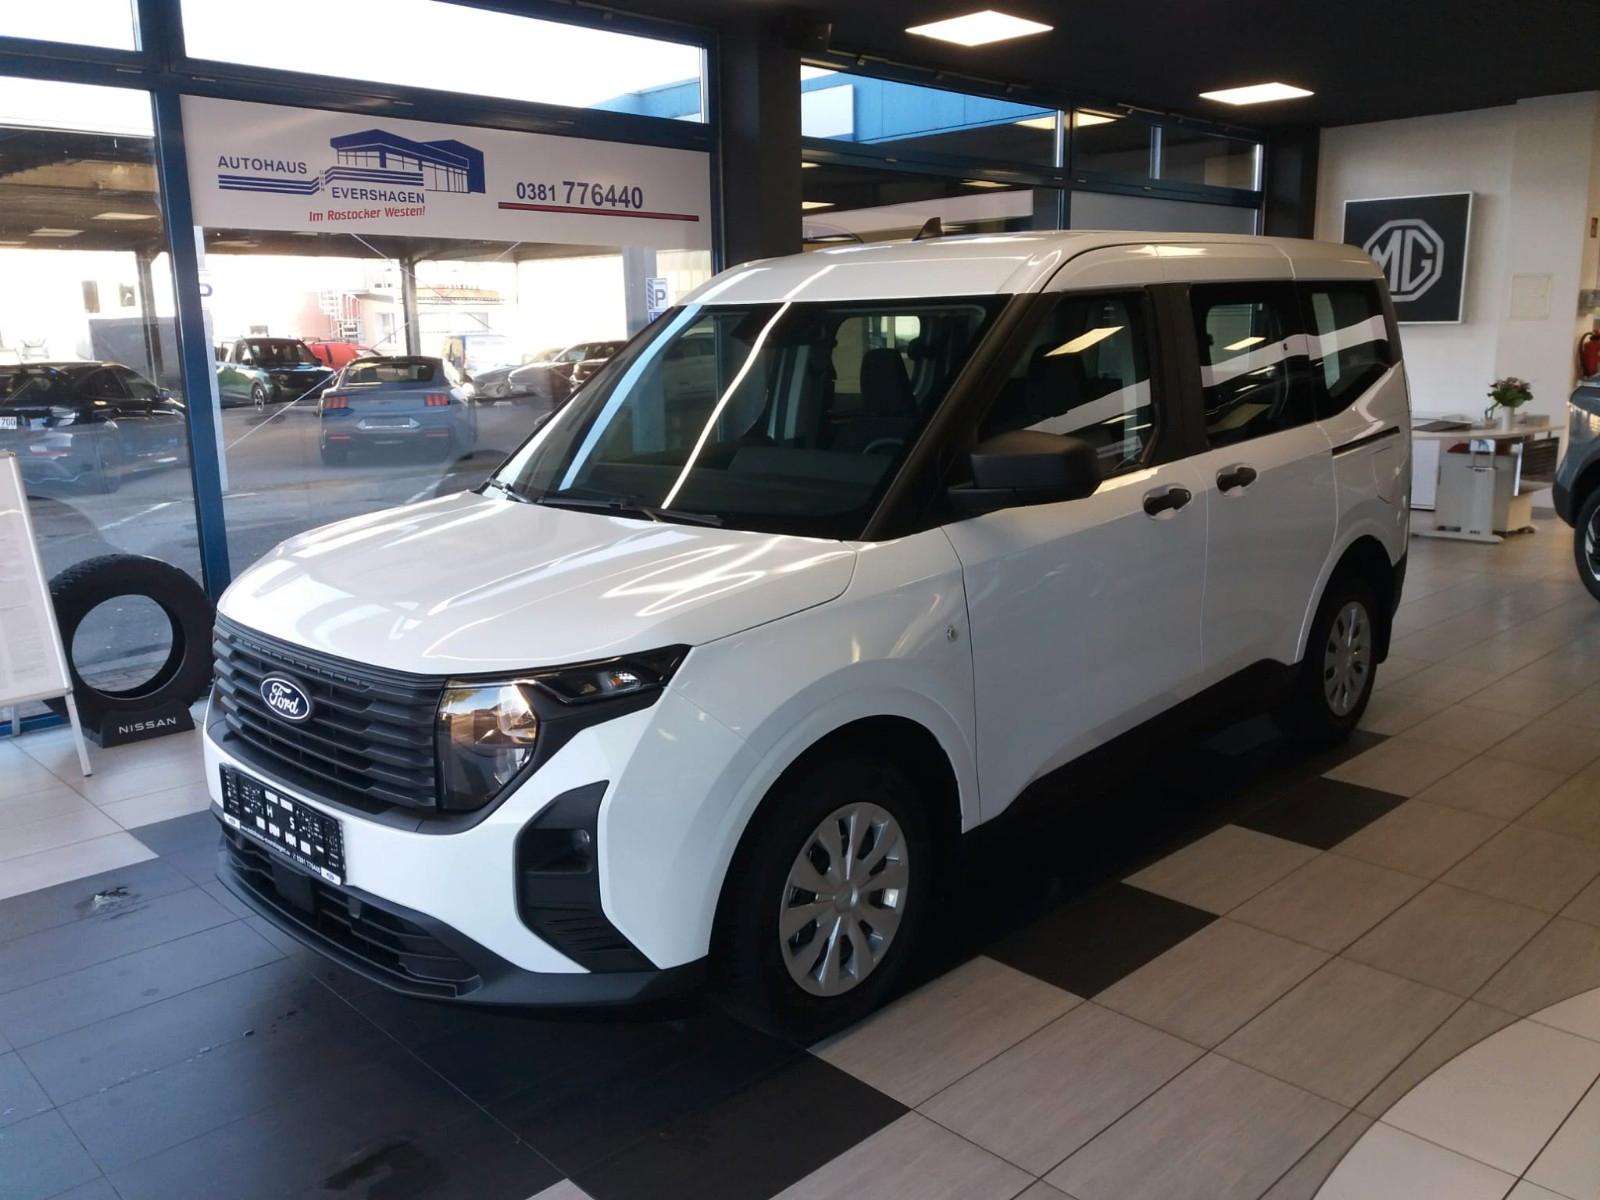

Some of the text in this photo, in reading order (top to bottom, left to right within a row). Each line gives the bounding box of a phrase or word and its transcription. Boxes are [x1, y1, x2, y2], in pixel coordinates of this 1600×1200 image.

[218, 155, 307, 174] AUTOHAUS
[331, 186, 425, 204] EVERSHAGEN
[516, 180, 644, 209] 0381 776440
[309, 205, 426, 222] Im Rostocker Westen!
[1372, 228, 1434, 292] MG
[655, 288, 666, 307] P
[269, 682, 299, 714] Ford
[118, 717, 176, 734] NISSAN
